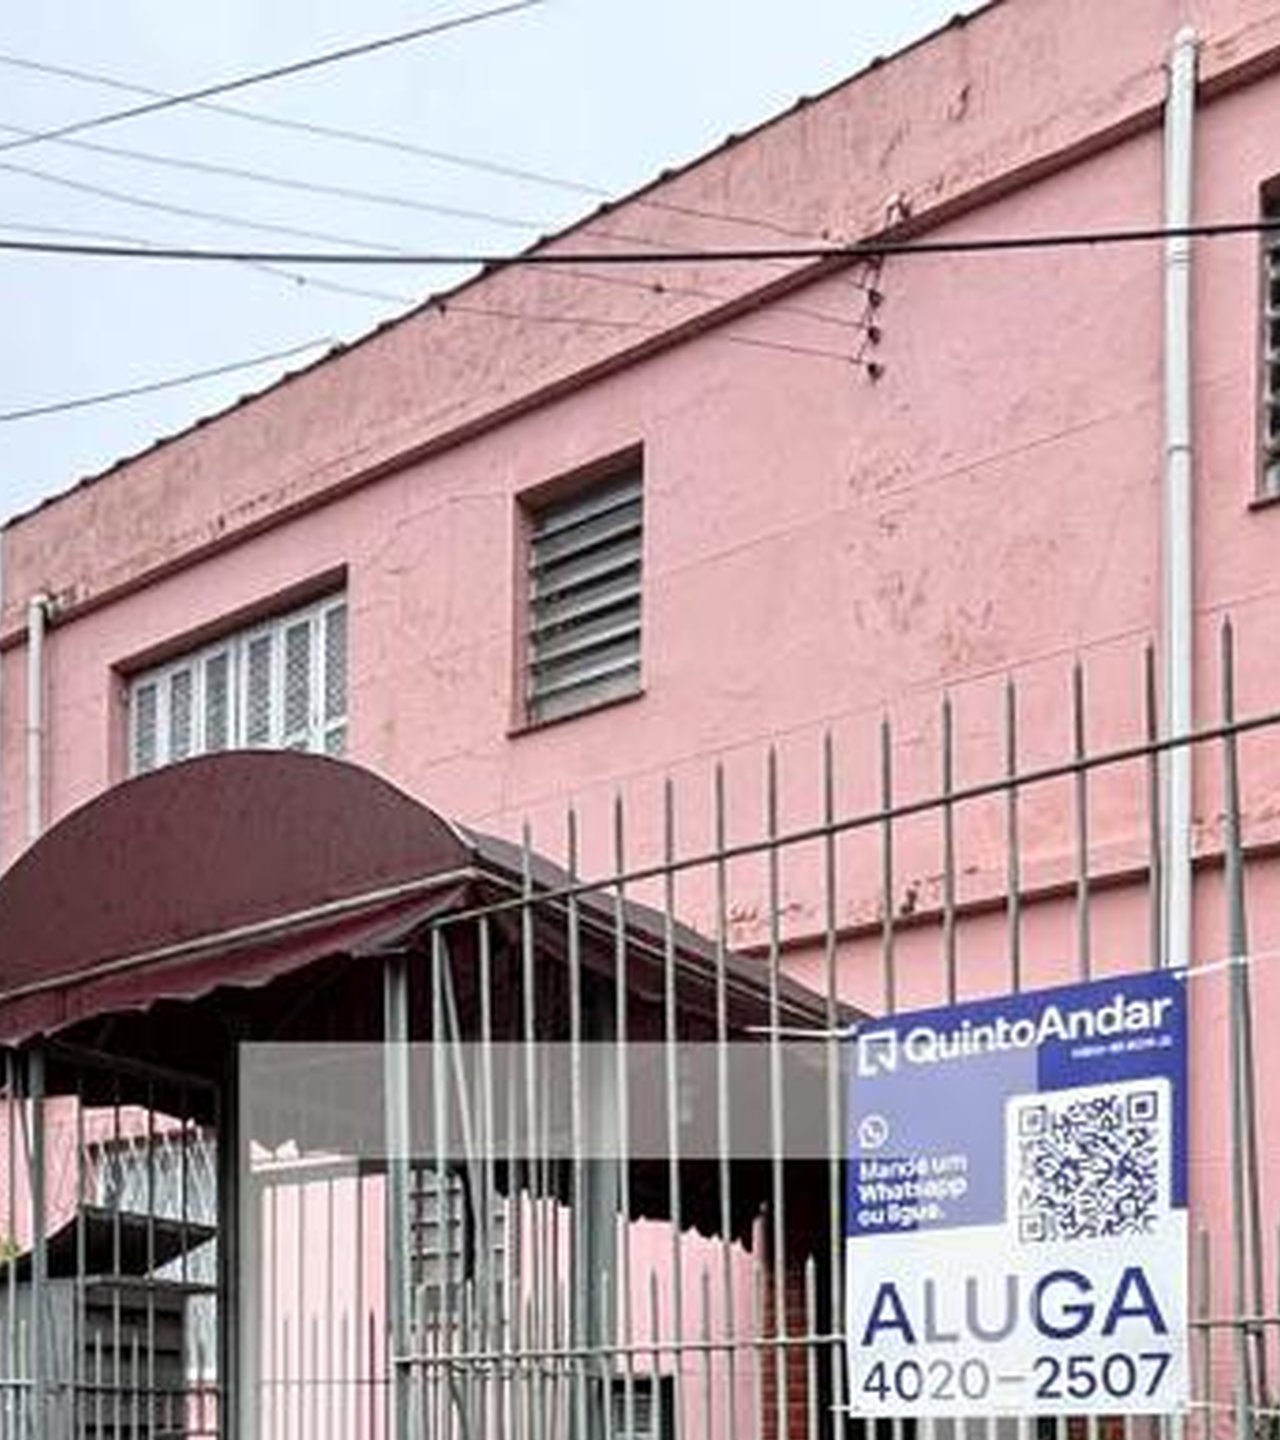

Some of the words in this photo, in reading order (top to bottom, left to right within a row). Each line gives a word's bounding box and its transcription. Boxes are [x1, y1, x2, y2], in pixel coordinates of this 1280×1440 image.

[903, 994, 1173, 1064] QuintoAndar
[931, 1155, 968, 1174] um
[858, 1209, 885, 1228] ou
[860, 1266, 1169, 1347] ALUGA
[862, 1352, 1172, 1401] 4020-2507
